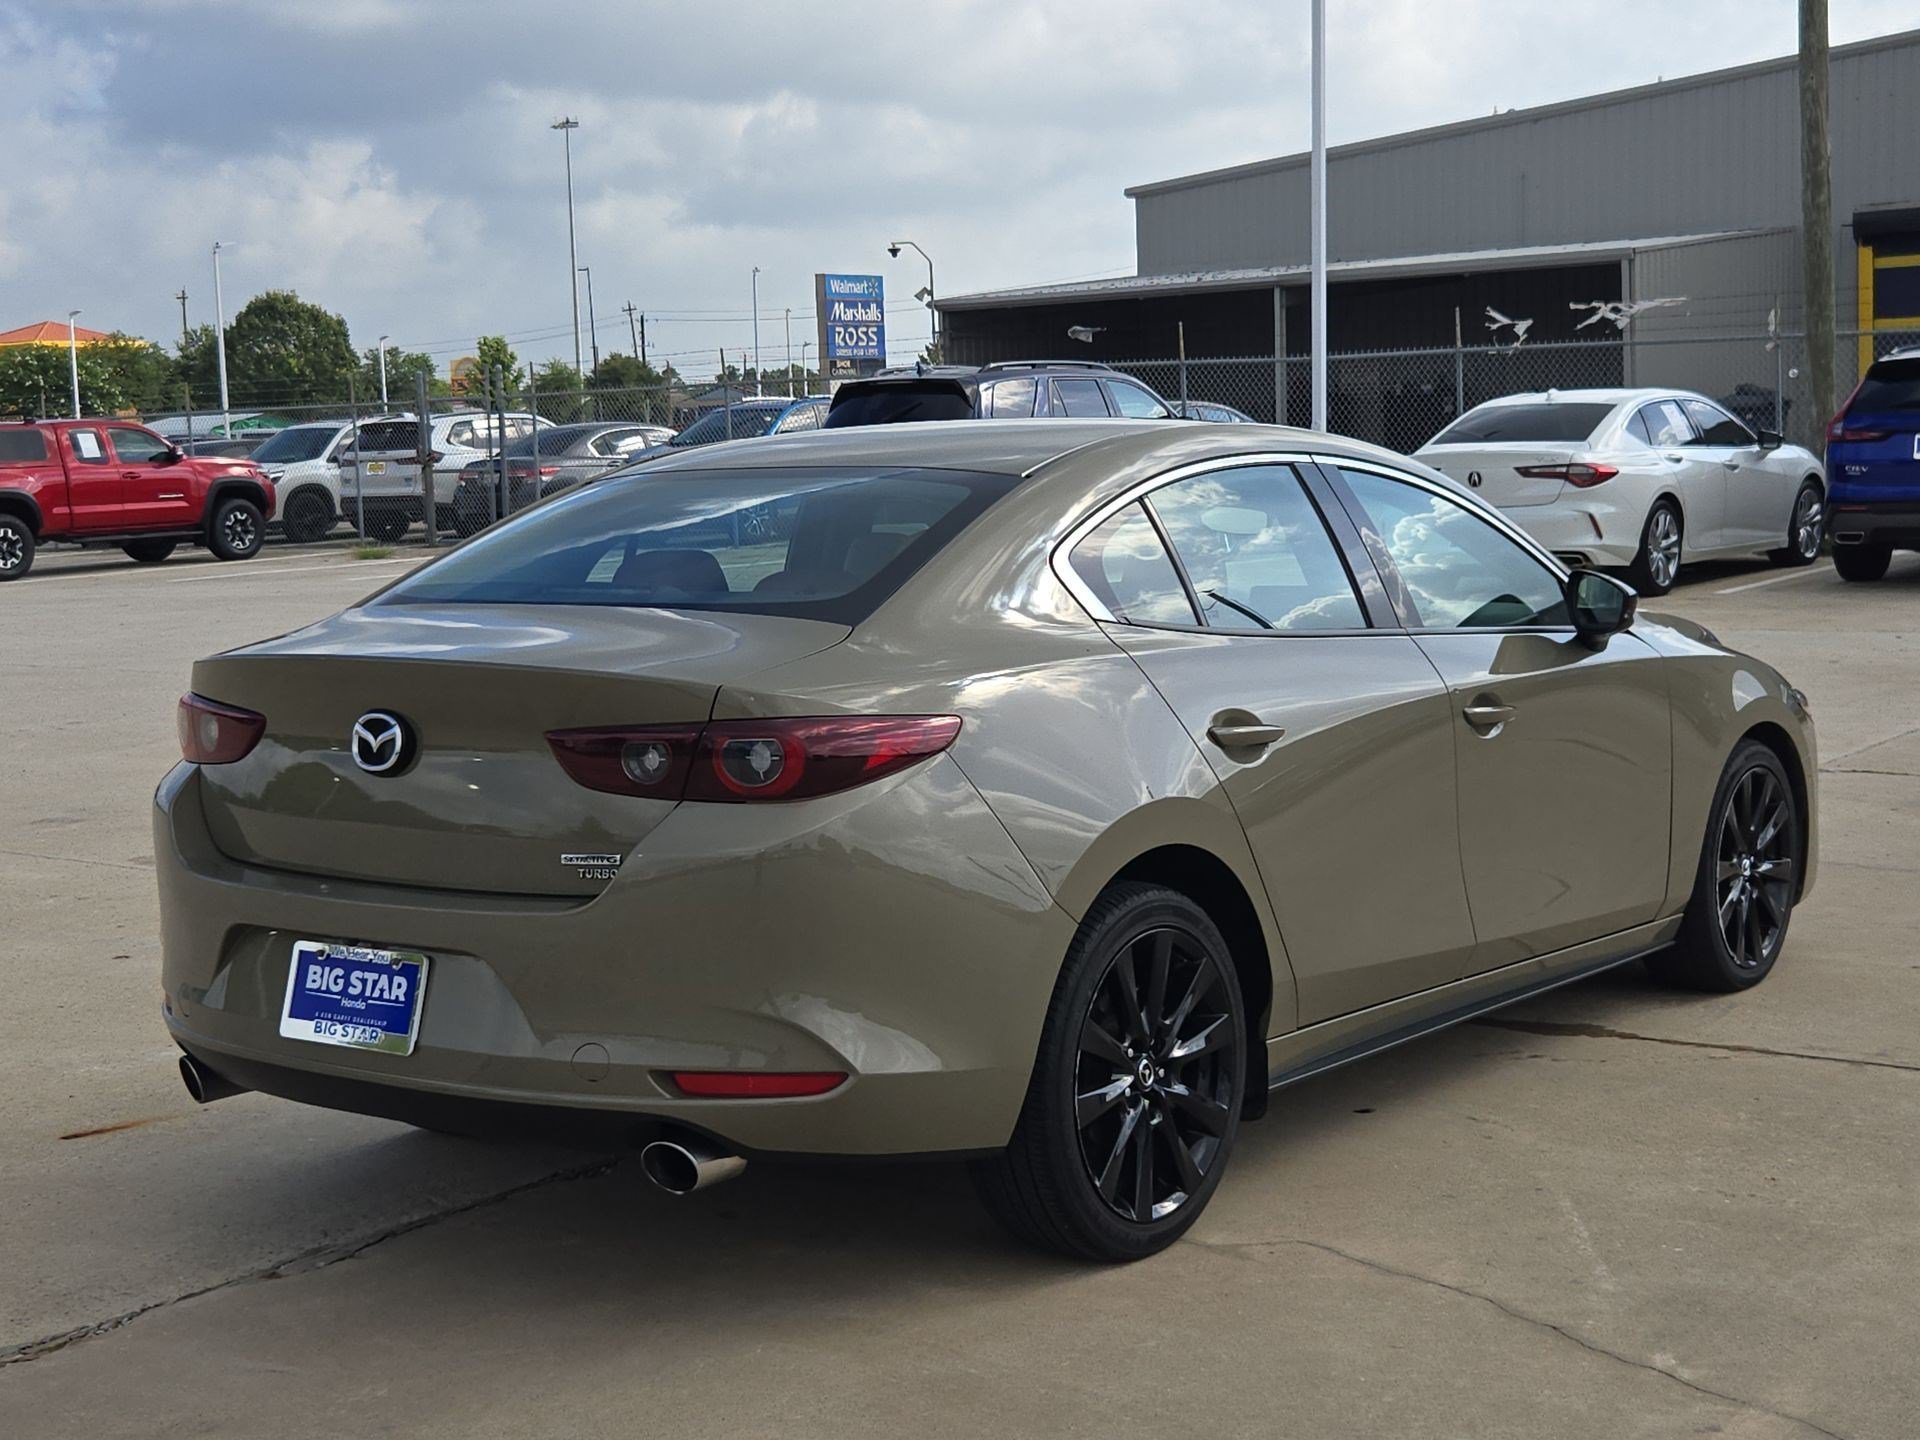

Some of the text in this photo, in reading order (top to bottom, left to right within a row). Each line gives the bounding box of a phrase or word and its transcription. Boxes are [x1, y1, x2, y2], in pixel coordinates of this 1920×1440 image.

[830, 279, 868, 294] Walmart
[830, 301, 882, 321] Marshalls
[835, 326, 878, 346] ROSS
[577, 868, 618, 879] TURBO
[371, 950, 390, 963] You
[305, 965, 408, 1002] BIG STAR
[341, 997, 366, 1010] Honda
[313, 1020, 380, 1043] BIG STAR
